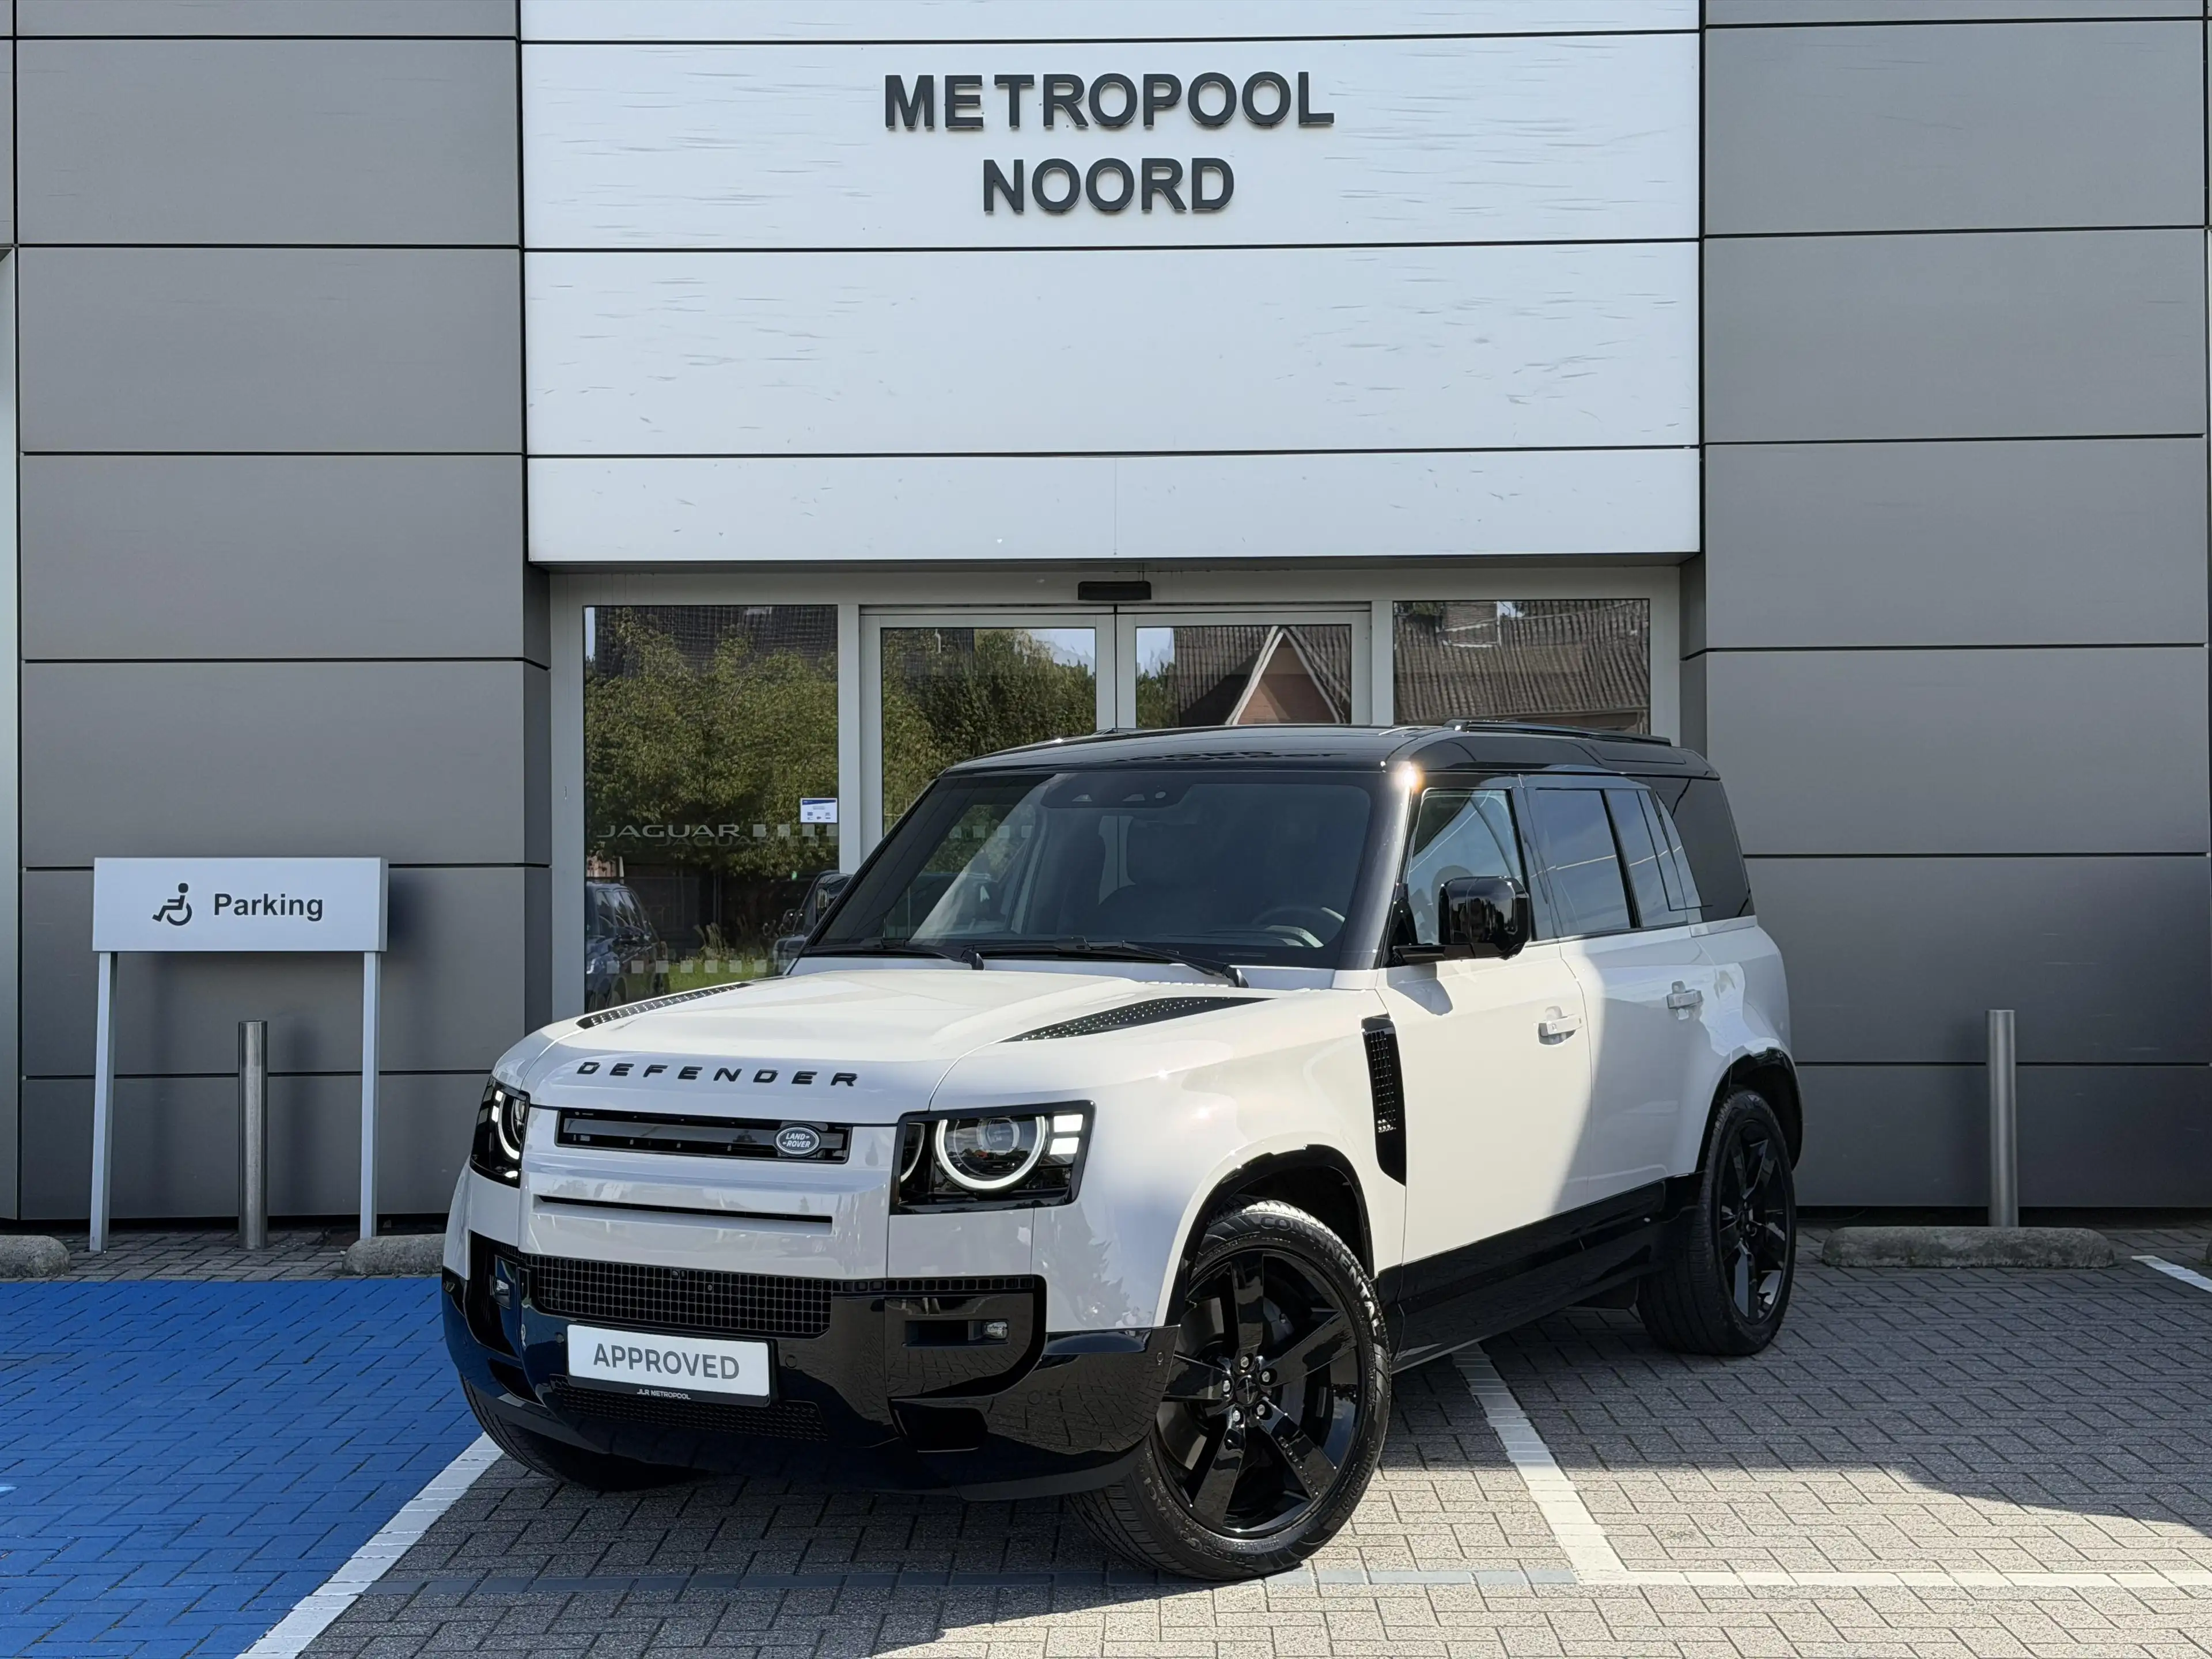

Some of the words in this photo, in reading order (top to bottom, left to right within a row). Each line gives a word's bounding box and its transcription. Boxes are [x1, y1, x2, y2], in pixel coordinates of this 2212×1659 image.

[885, 71, 1335, 130] METROPOOL
[983, 158, 1235, 213] NOORD
[597, 824, 741, 838] JAGUAR
[213, 892, 324, 922] Parking
[576, 1062, 858, 1088] DEFENDER
[785, 1132, 806, 1141] LAND
[786, 1140, 811, 1148] ROVER
[593, 1343, 740, 1380] APPROVED
[650, 1389, 691, 1400] METROPOOL
